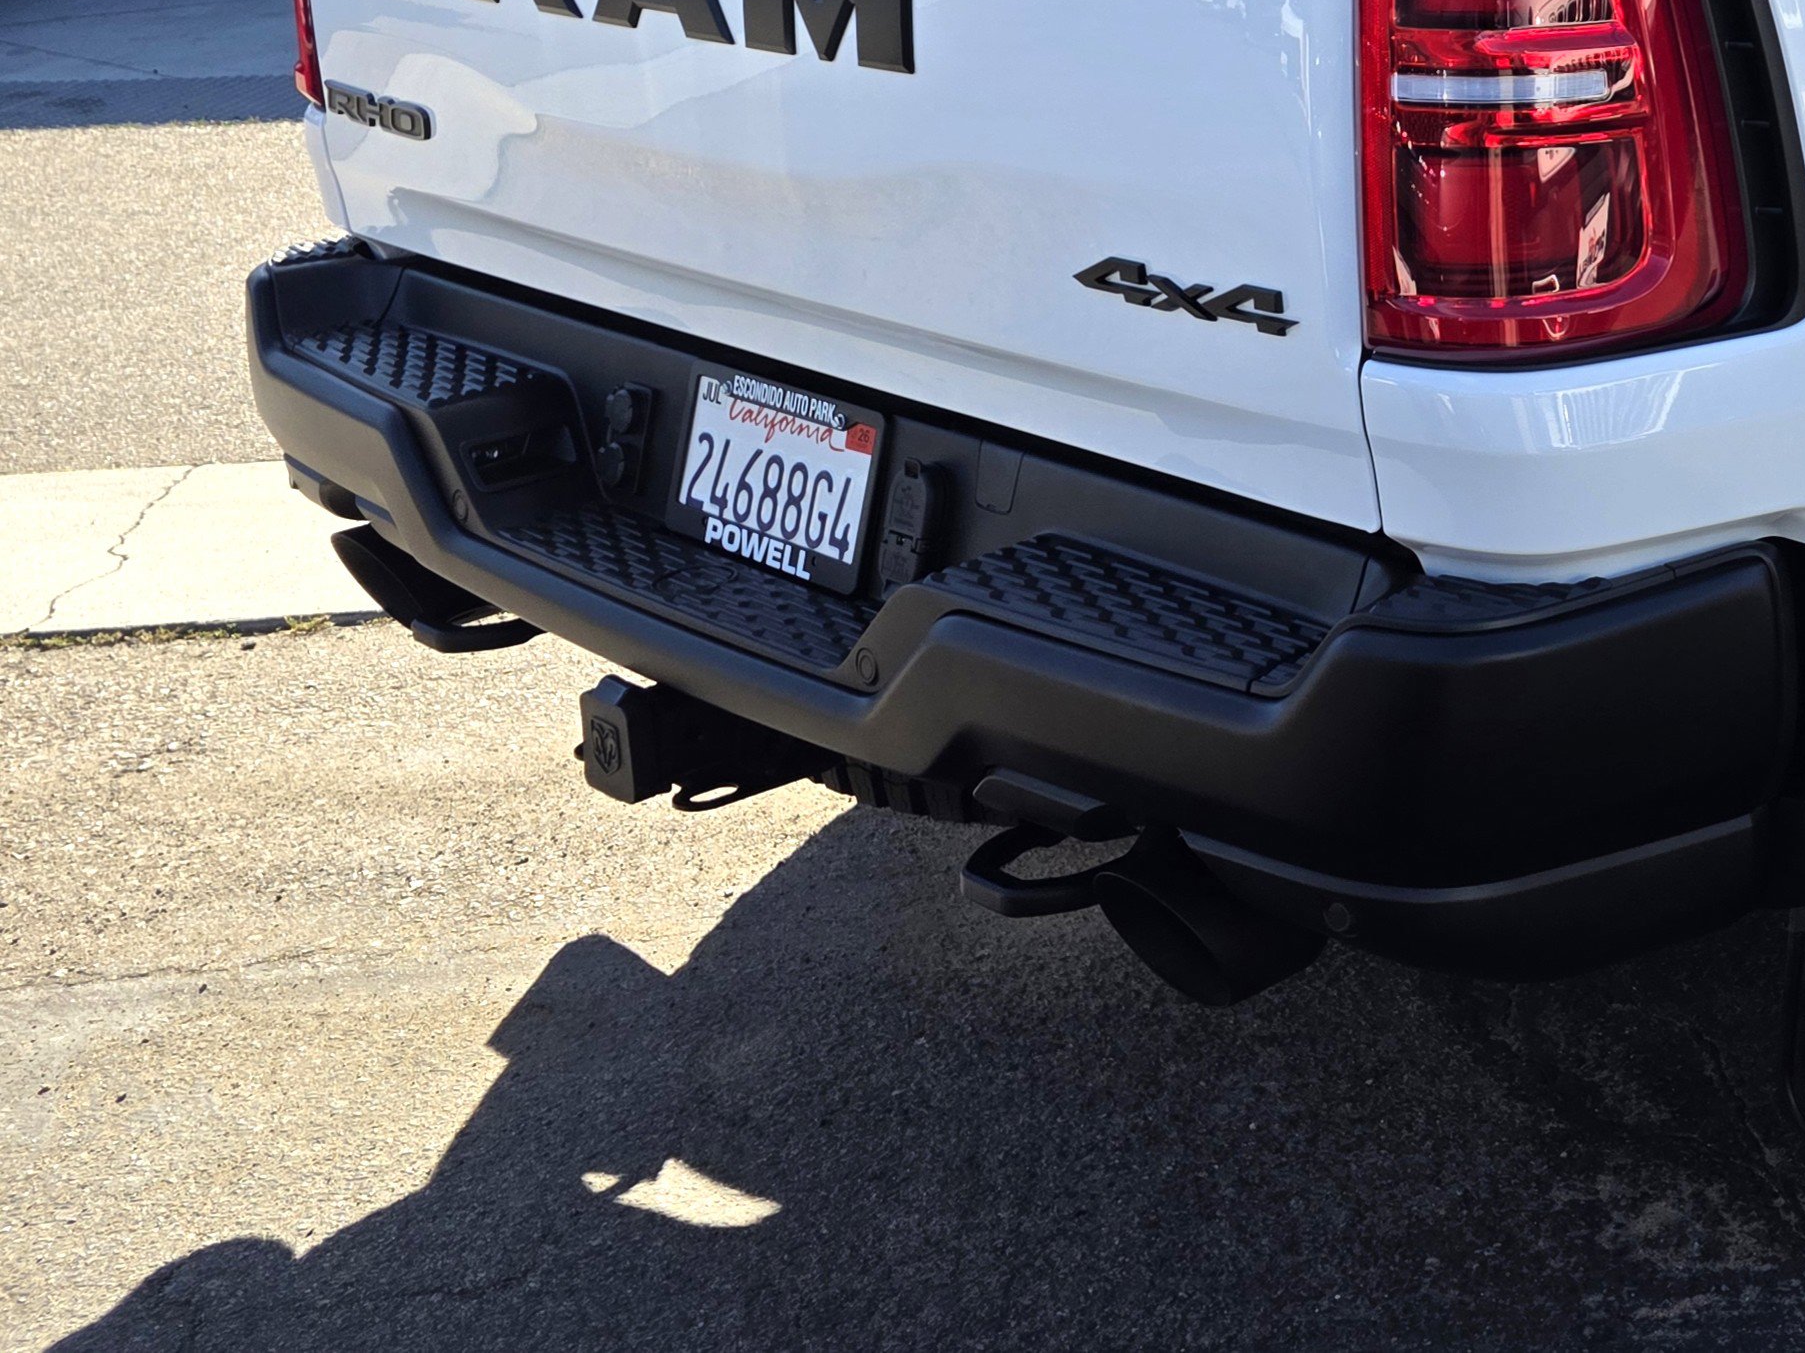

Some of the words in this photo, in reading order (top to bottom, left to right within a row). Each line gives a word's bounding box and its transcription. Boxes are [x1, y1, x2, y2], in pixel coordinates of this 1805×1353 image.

[324, 79, 432, 140] RHO
[702, 380, 722, 405] JUL
[732, 375, 783, 407] ESCONDIDO
[784, 391, 809, 416] AUTO
[808, 398, 837, 424] PARK
[729, 398, 845, 452] California
[857, 427, 871, 443] 26
[686, 432, 852, 561] 24688G4
[704, 516, 811, 580] POWELL
